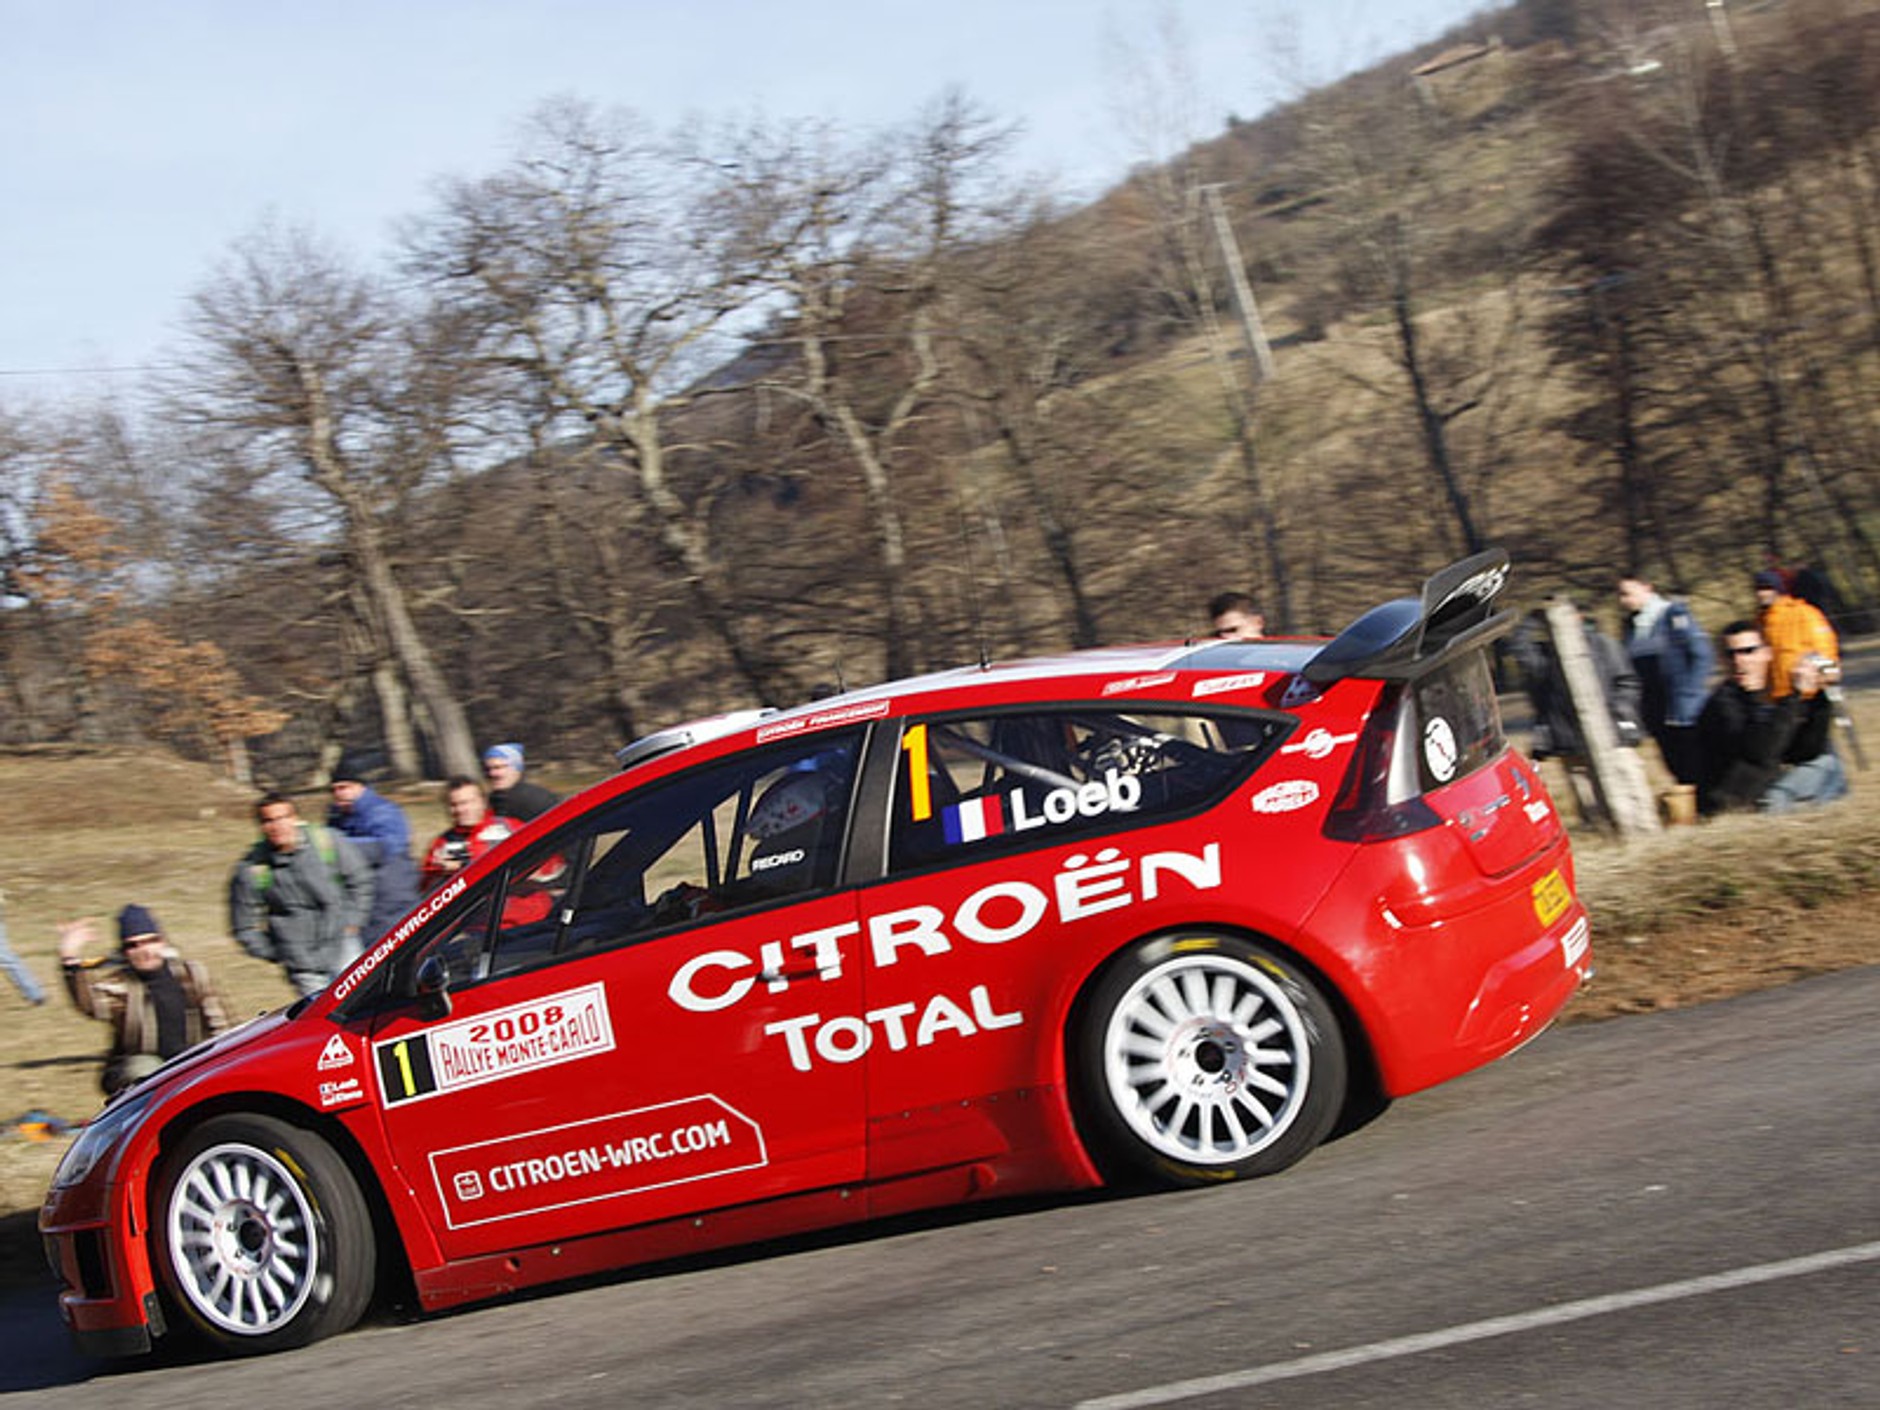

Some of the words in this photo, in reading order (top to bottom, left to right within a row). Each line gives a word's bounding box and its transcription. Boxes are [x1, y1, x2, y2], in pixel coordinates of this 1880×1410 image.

[902, 723, 932, 822] 1
[1010, 767, 1142, 832] Loeb
[334, 877, 467, 1000] CITROEN-WRC.COM
[667, 842, 1222, 1012] CITROËN
[439, 1042, 495, 1081] RALLYE
[496, 1002, 601, 1065] MONTE-CARLO
[469, 1005, 565, 1043] 2008
[765, 984, 1024, 1072] TOTAL
[393, 1039, 417, 1097] 1
[488, 1119, 732, 1192] CITROEN-WRC.COM
